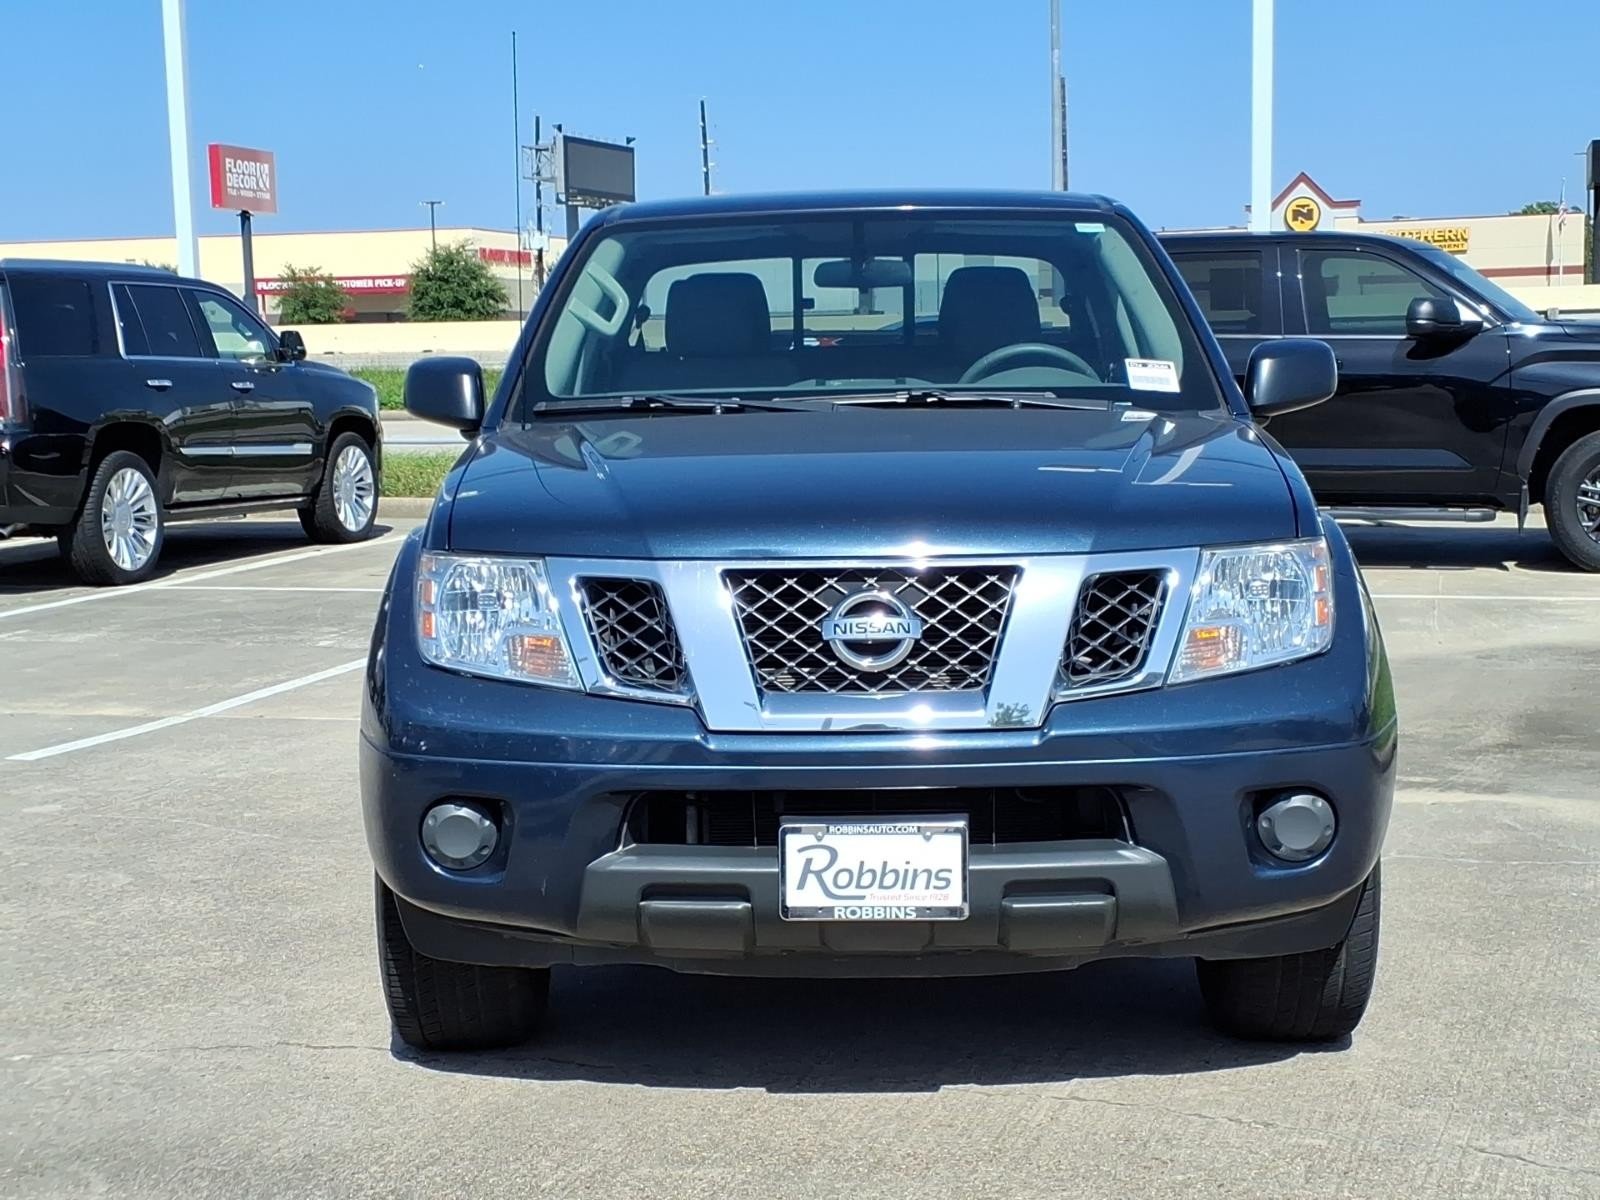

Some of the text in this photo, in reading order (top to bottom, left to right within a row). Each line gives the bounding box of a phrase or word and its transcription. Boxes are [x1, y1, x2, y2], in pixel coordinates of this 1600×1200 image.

[225, 157, 256, 176] FLOOR
[226, 172, 257, 190] DECOR
[833, 622, 911, 635] NISSAN
[829, 825, 918, 834] ROBBINSAUTO.COM
[796, 843, 953, 901] Robbins
[903, 893, 928, 901] Since
[834, 906, 917, 919] ROBBINS
